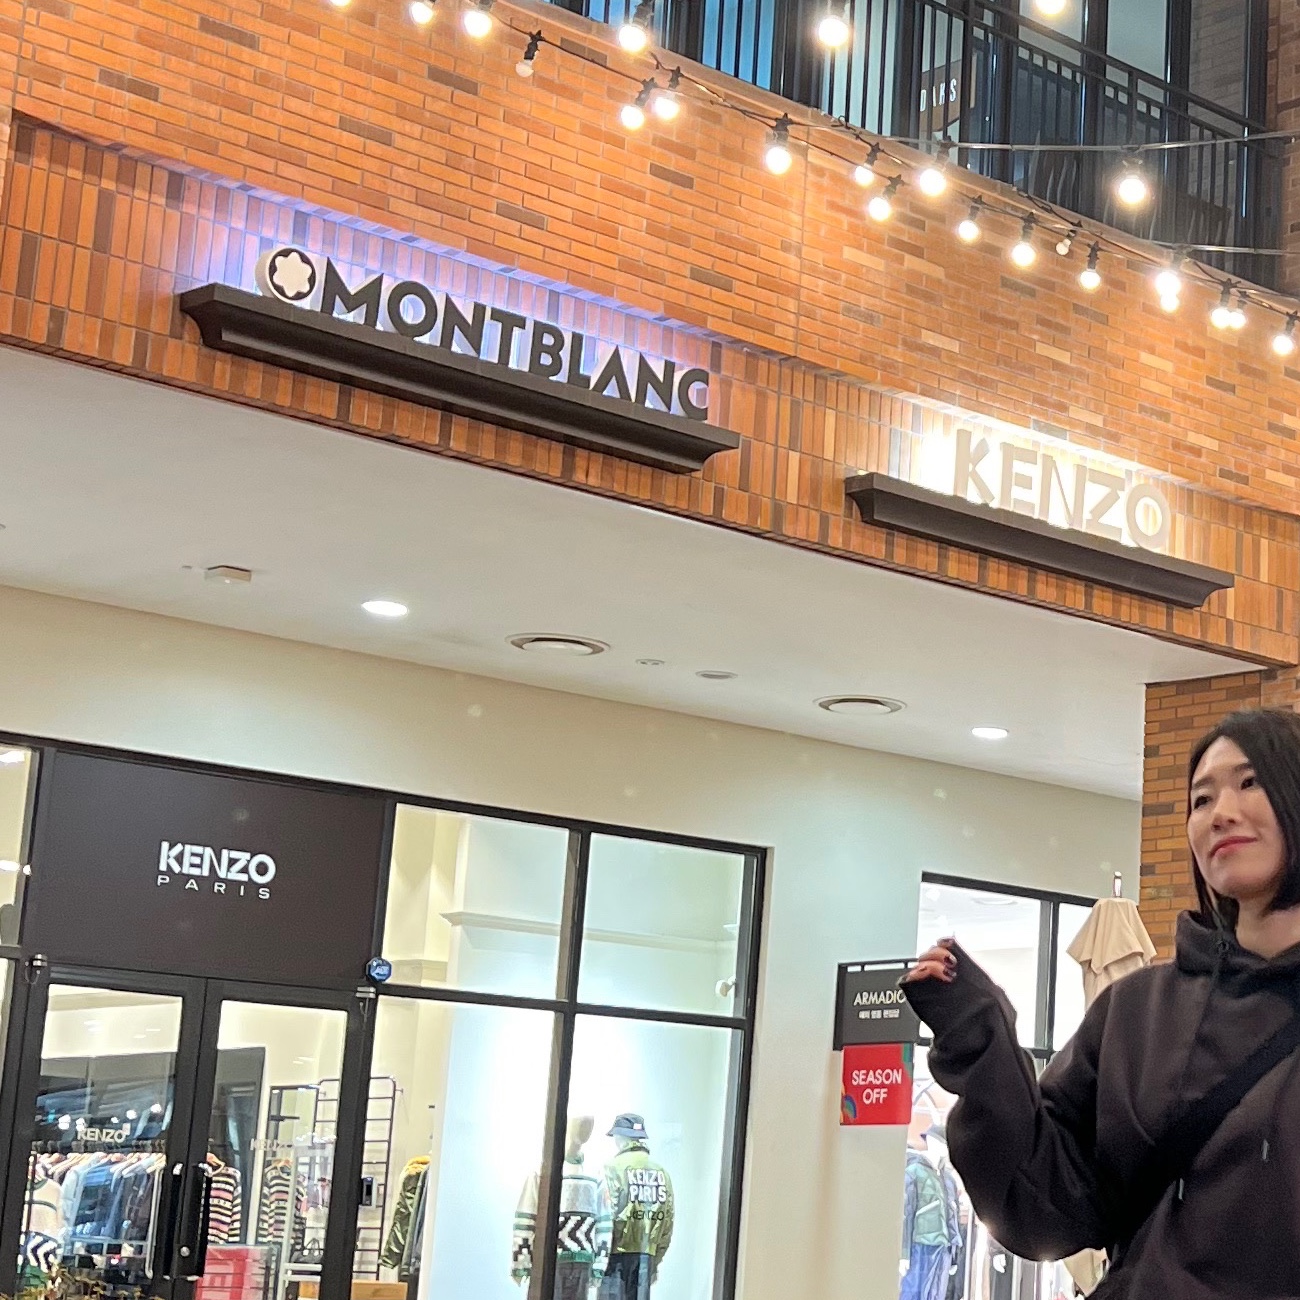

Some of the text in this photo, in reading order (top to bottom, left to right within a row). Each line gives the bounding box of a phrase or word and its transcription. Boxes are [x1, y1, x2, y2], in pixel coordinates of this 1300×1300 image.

[321, 257, 710, 421] MONTBLANC
[954, 429, 1171, 550] KENZO
[159, 841, 276, 884] KENZO
[157, 875, 271, 900] PARIS
[851, 1068, 902, 1086] SEASON
[862, 1088, 888, 1105] OFF
[77, 1128, 127, 1143] KENZO
[627, 1169, 666, 1186] KENZO
[629, 1185, 667, 1202] PARIS
